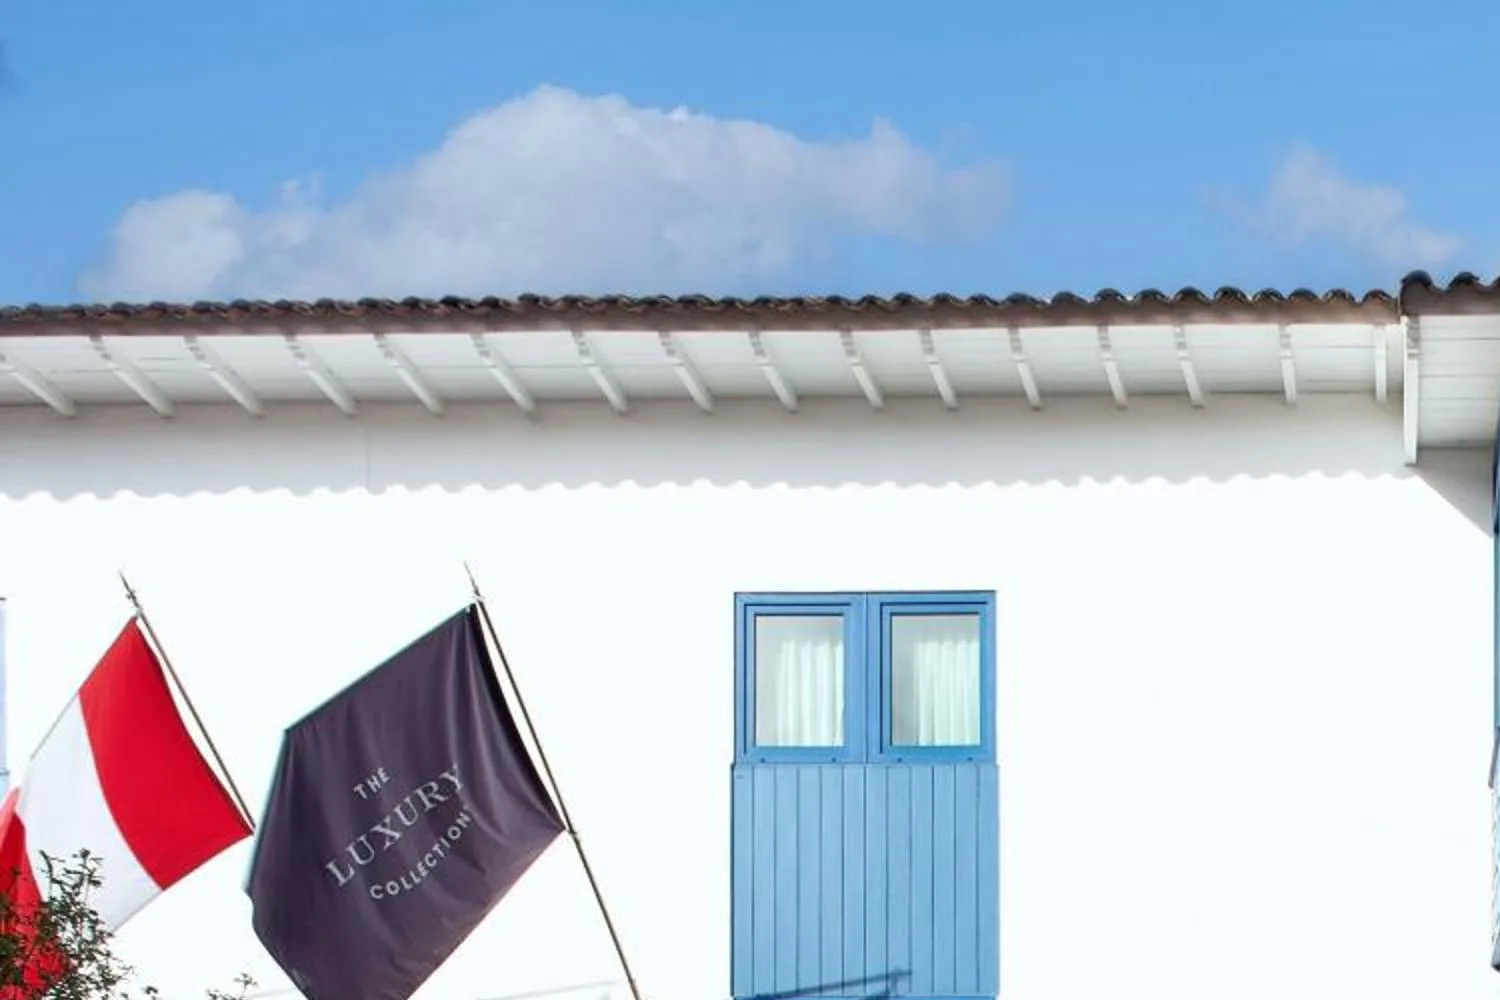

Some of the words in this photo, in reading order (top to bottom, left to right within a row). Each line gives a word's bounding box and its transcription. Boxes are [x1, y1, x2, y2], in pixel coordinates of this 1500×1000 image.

[326, 763, 463, 887] LUXURY
[353, 767, 390, 799] THE
[369, 811, 472, 899] COLLECTION
